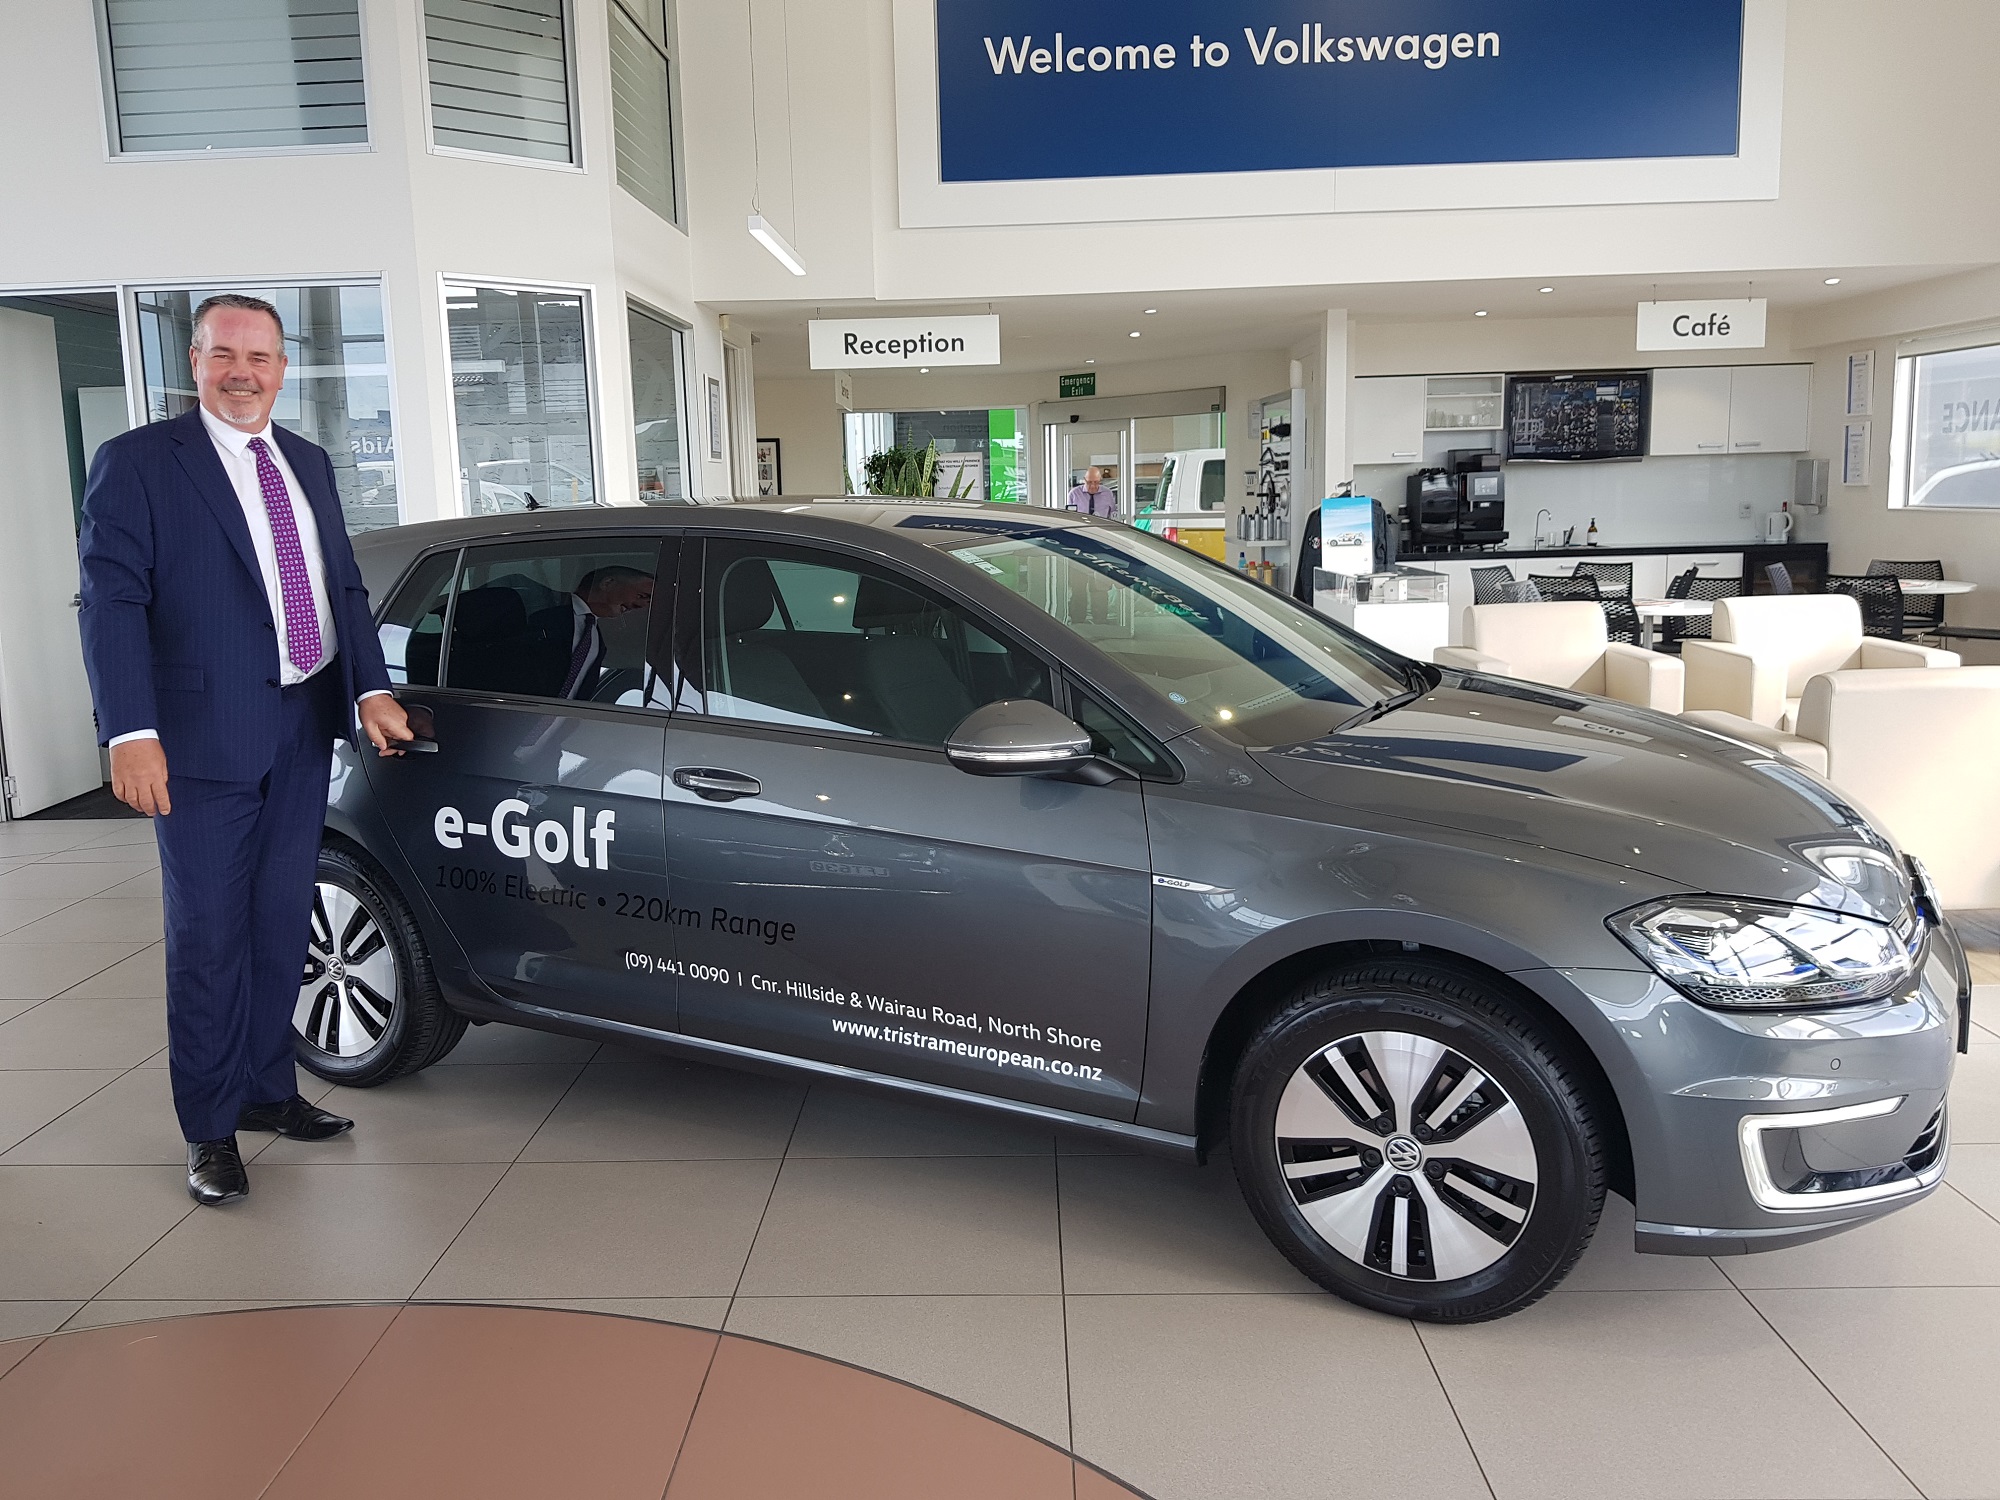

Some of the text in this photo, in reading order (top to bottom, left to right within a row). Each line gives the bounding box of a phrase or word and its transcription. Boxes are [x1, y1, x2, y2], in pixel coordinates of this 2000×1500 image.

[983, 23, 1500, 75] Welcome to Volkswagen
[843, 331, 965, 359] Reception
[1672, 312, 1731, 337] Café
[1060, 376, 1094, 386] Emergency
[1071, 386, 1084, 396] Exit
[434, 798, 616, 871] e-Golf
[435, 865, 796, 946] 100% Electric 220km Range
[625, 951, 654, 974] (09)
[657, 957, 686, 976] 441
[690, 963, 730, 984] 0090
[751, 974, 783, 994] Cnr.
[786, 980, 845, 1005] Hillside
[850, 992, 863, 1009] &
[866, 994, 927, 1020] Wairau
[932, 1006, 983, 1034] Road,
[988, 1016, 1041, 1041] North
[1046, 1026, 1102, 1052] Shore
[832, 1018, 1103, 1081] www.tristrameuropean.co.nz
